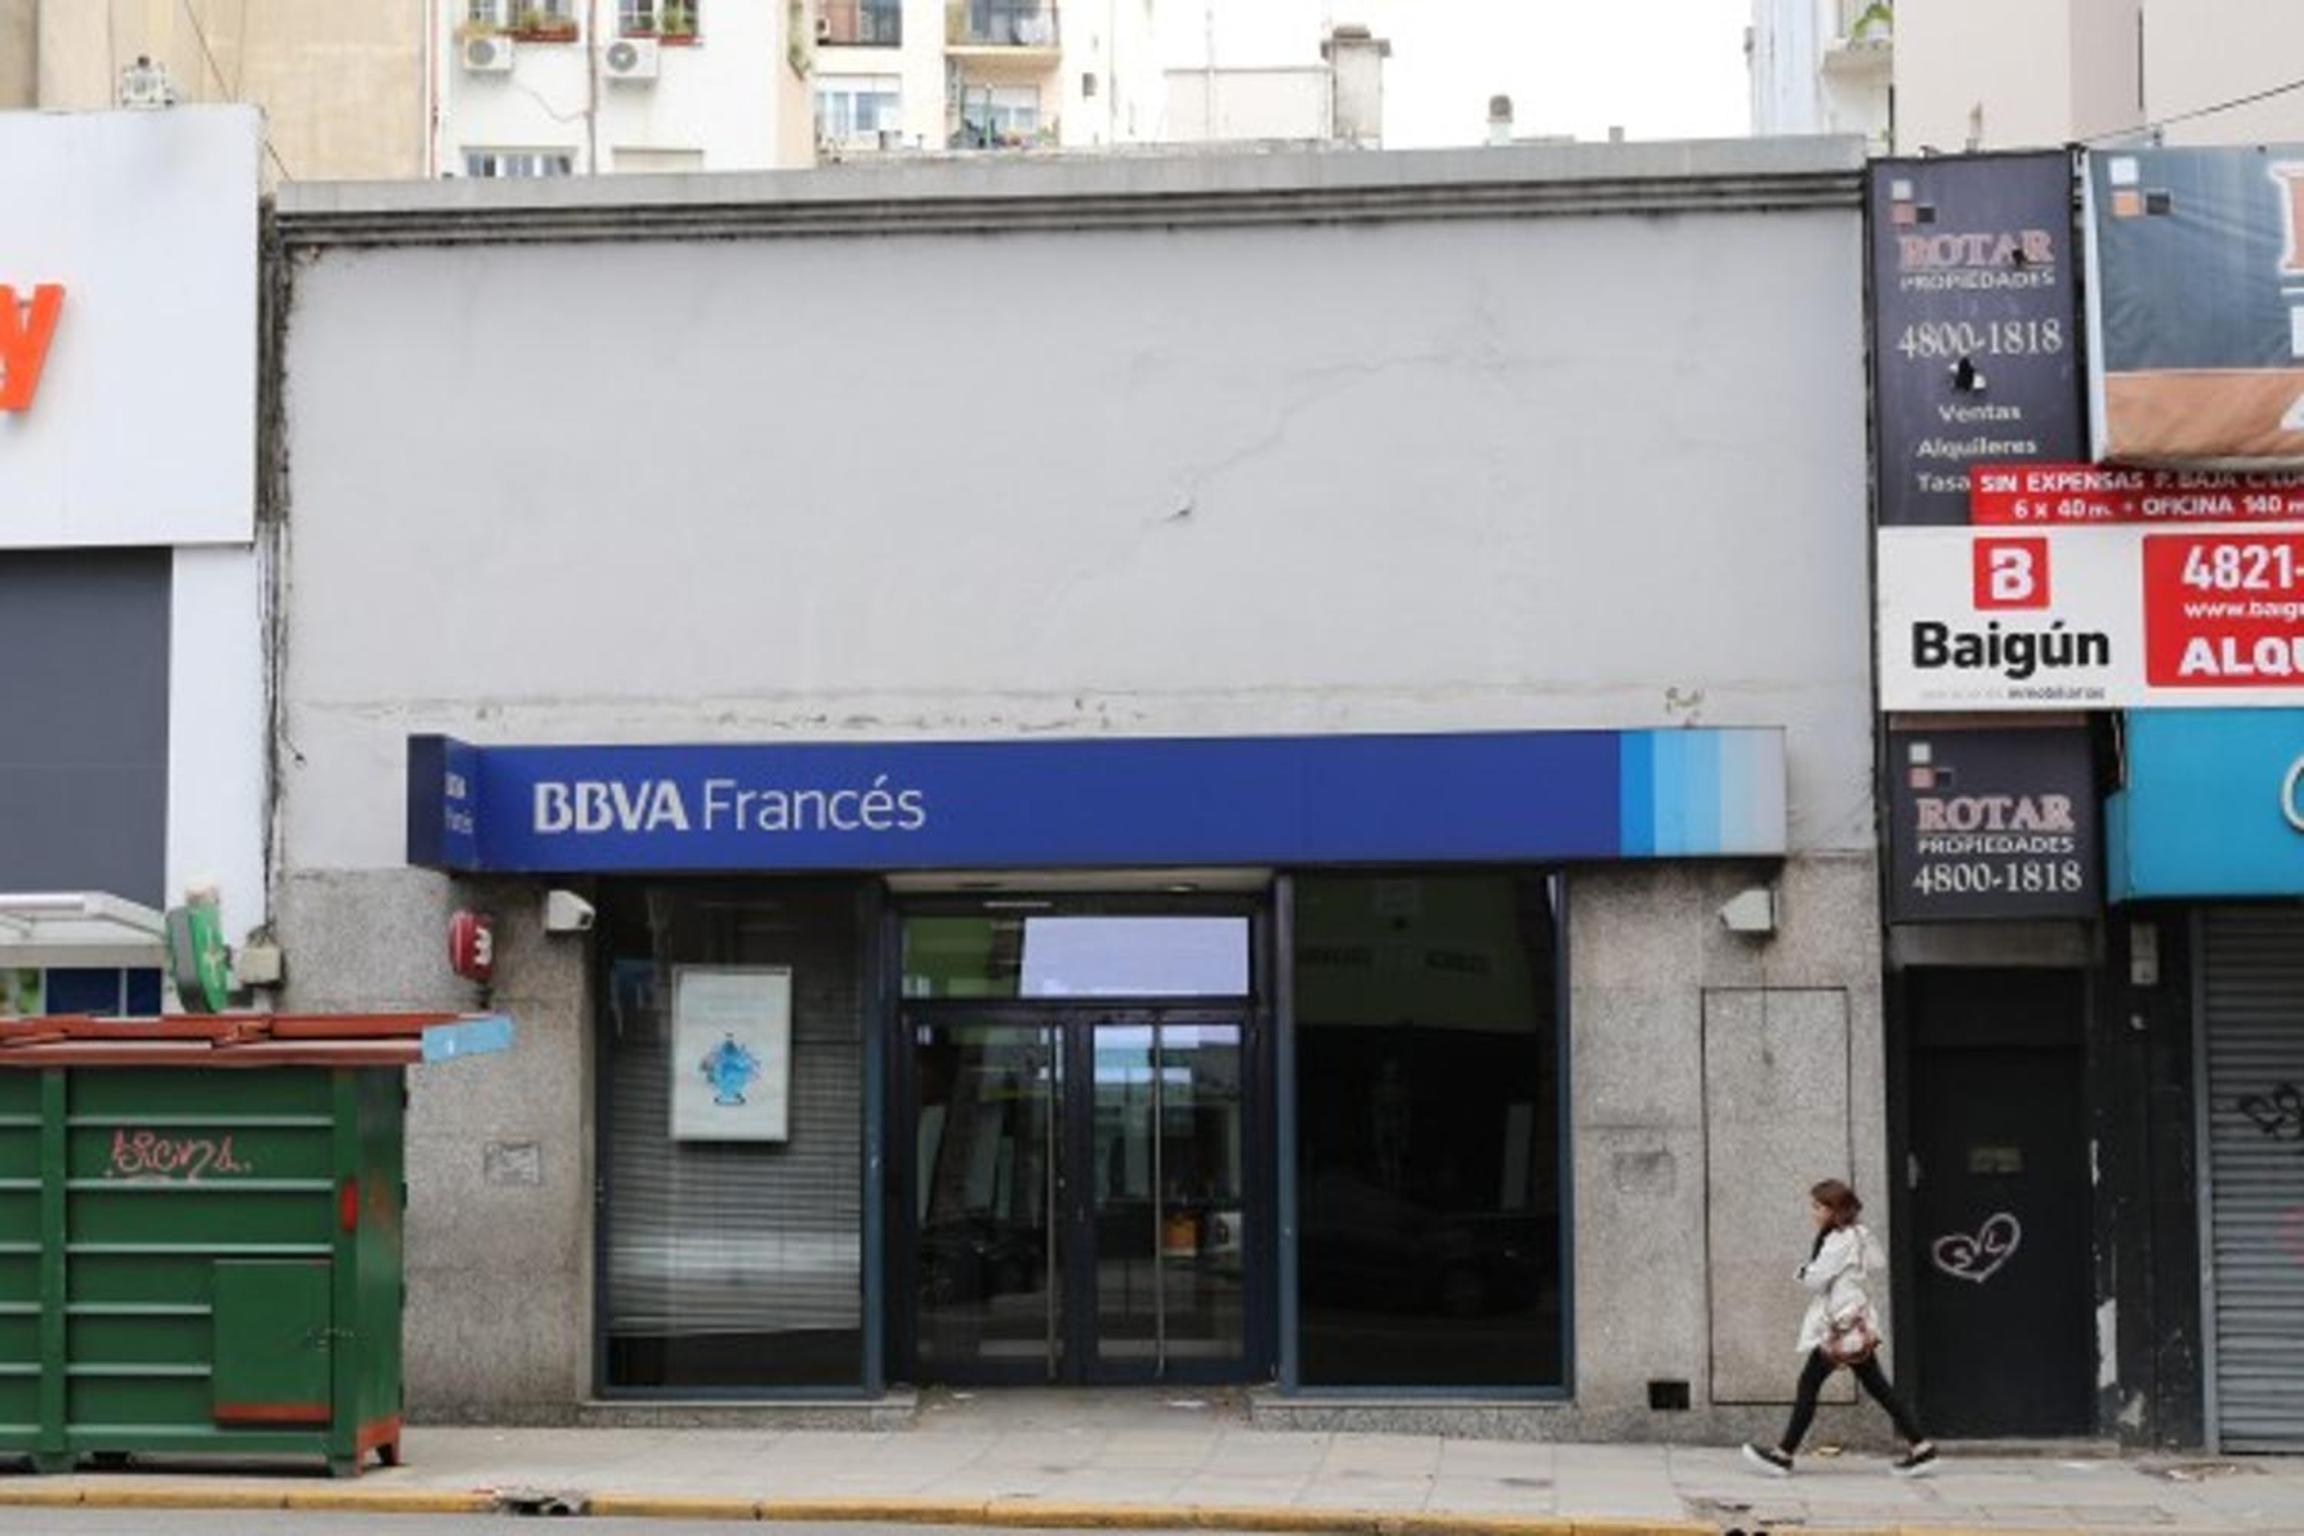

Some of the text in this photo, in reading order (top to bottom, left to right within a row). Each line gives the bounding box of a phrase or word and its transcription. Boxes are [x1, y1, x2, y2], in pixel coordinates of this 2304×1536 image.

[1899, 230, 2055, 267] ROTAR
[1900, 270, 2056, 290] PROPIEDADES
[1898, 318, 2063, 358] 4800-1818
[1937, 404, 2021, 422] Ventas
[1916, 437, 2037, 461] Alquileres
[1981, 474, 2017, 493] SIN
[2027, 471, 2144, 492] EXPENSAS
[2014, 500, 2028, 519] 6
[2057, 499, 2086, 516] 40
[2142, 495, 2235, 516] OFICINA
[2243, 495, 2282, 514] 140
[2184, 600, 2304, 623] www.baig
[1912, 620, 2110, 680] Baigún
[533, 780, 690, 832] BBVA
[703, 774, 926, 831] Francés
[1916, 795, 2075, 833] ROTAR
[1917, 836, 2076, 853] PROPIEDADES
[1912, 860, 2083, 895] 4800-1818
